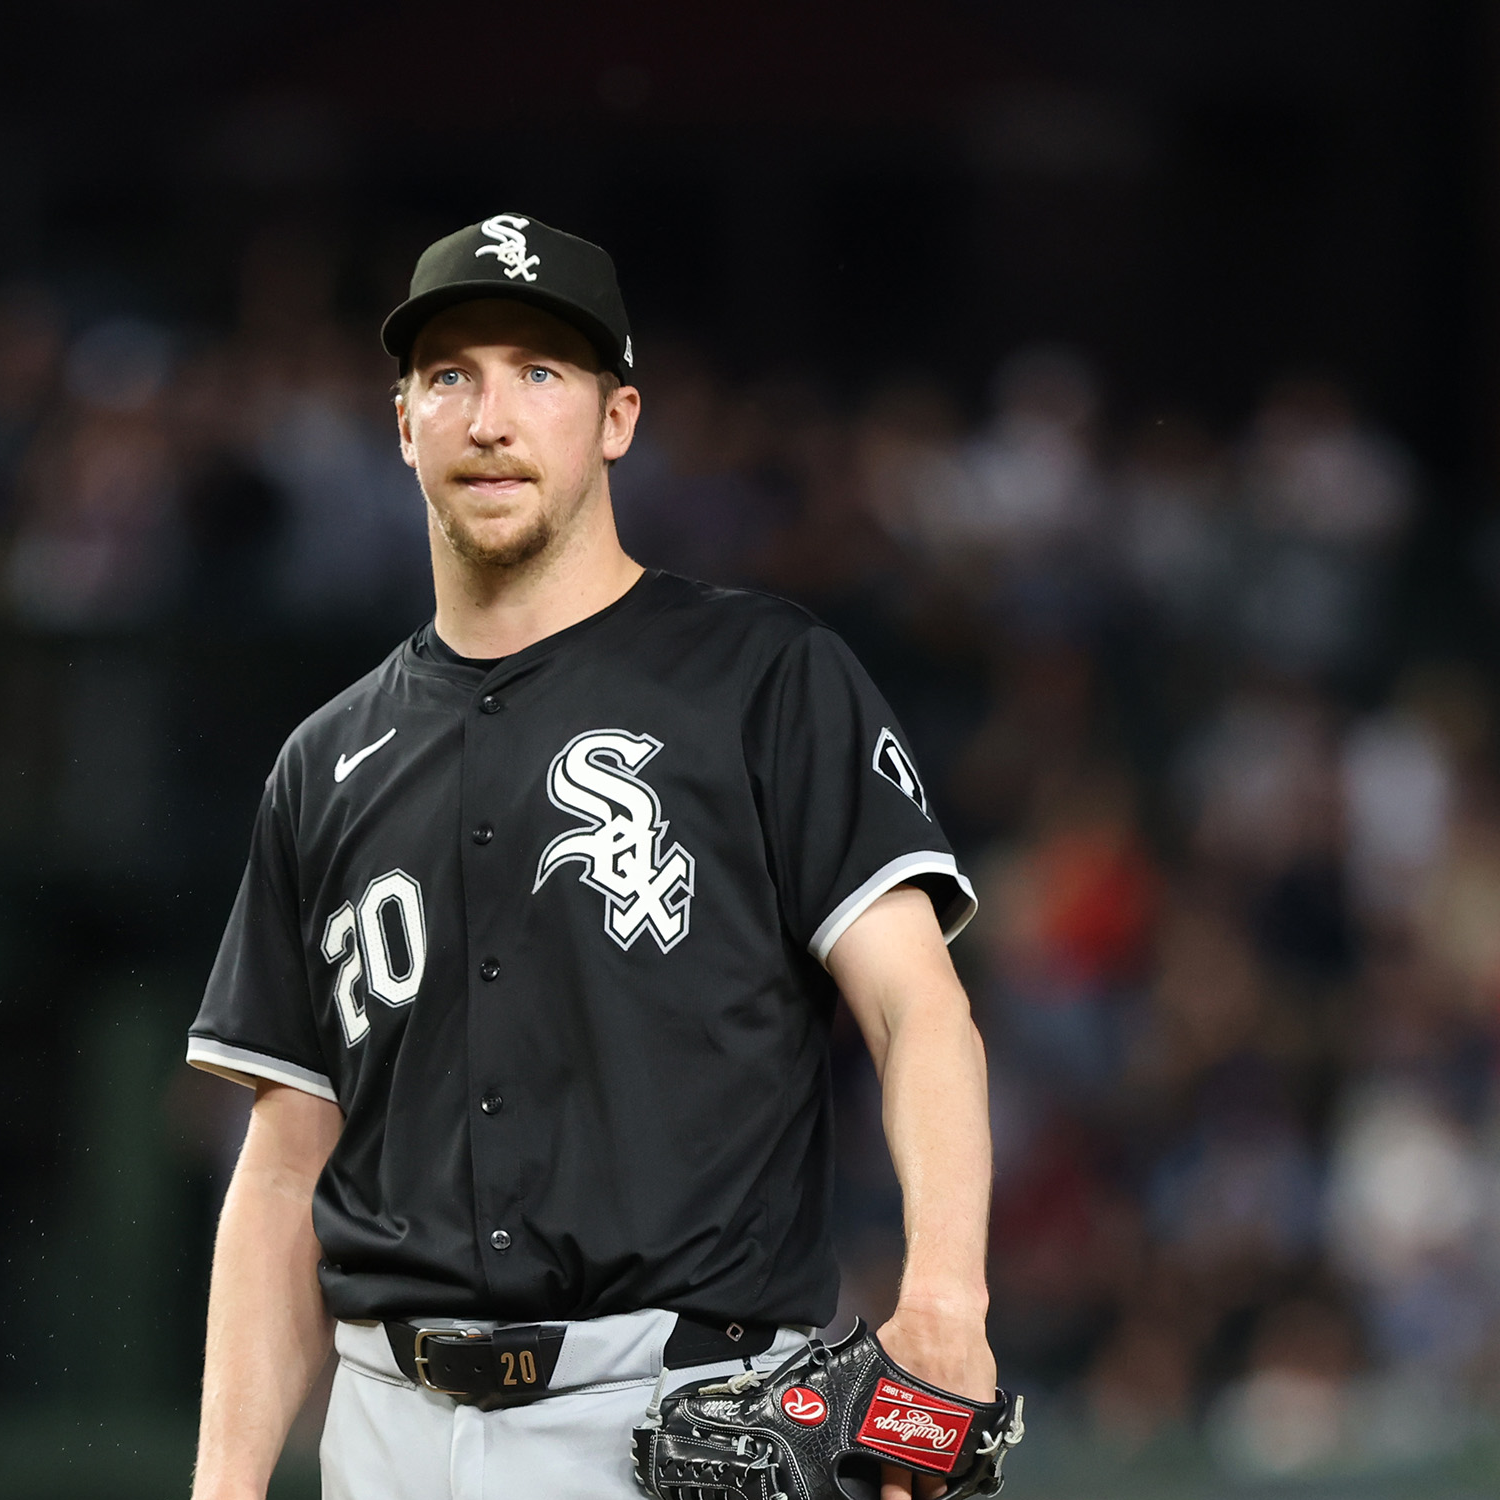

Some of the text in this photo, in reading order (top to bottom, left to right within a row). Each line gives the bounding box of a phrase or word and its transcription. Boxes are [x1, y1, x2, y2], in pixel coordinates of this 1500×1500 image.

[475, 215, 541, 282] Sox
[532, 728, 695, 954] Sox
[320, 867, 427, 1049] 20
[501, 1350, 537, 1386] 20
[873, 1409, 958, 1449] Rawlings
